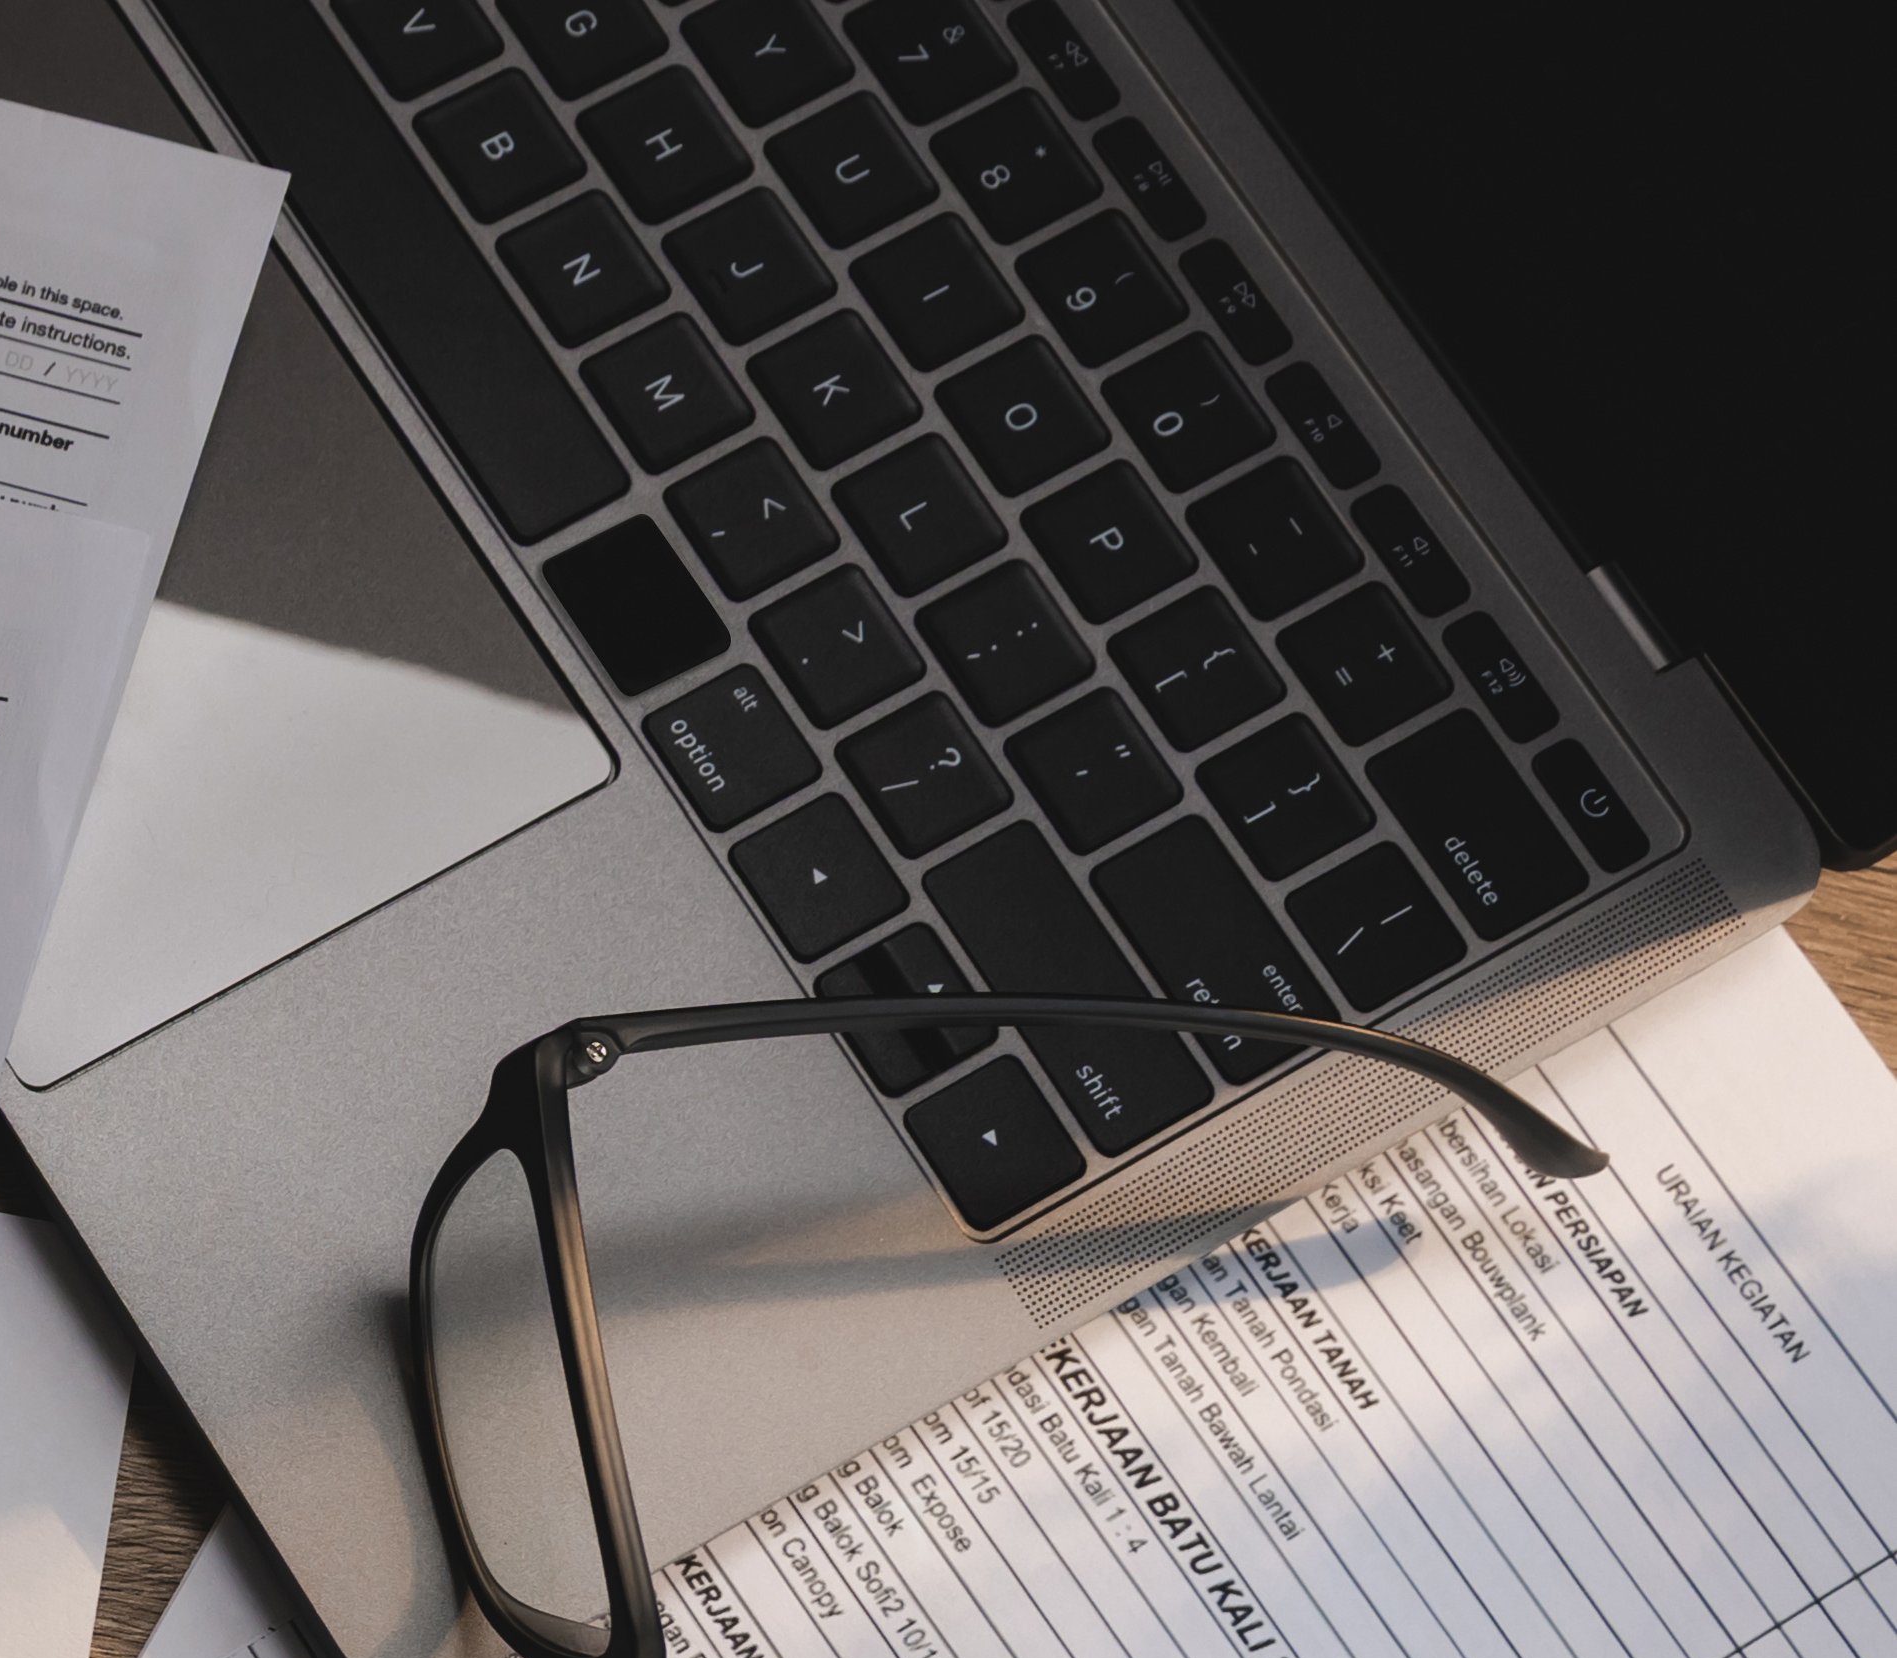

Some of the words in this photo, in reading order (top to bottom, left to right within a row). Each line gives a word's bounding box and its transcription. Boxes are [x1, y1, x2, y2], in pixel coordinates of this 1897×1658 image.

[645, 128, 683, 161] H
[835, 154, 870, 184] U
[563, 253, 601, 286] N
[645, 374, 685, 411] M
[813, 375, 850, 406] K
[1005, 403, 1038, 431] O
[1089, 527, 1124, 550] P
[733, 687, 758, 712] alt
[670, 719, 725, 792] option
[1444, 836, 1498, 906] delete
[1262, 964, 1302, 1017] enter
[1076, 1065, 1122, 1120] shift
[1657, 1164, 1726, 1251] URAIAN
[1717, 1249, 1810, 1364] KEGIATAN
